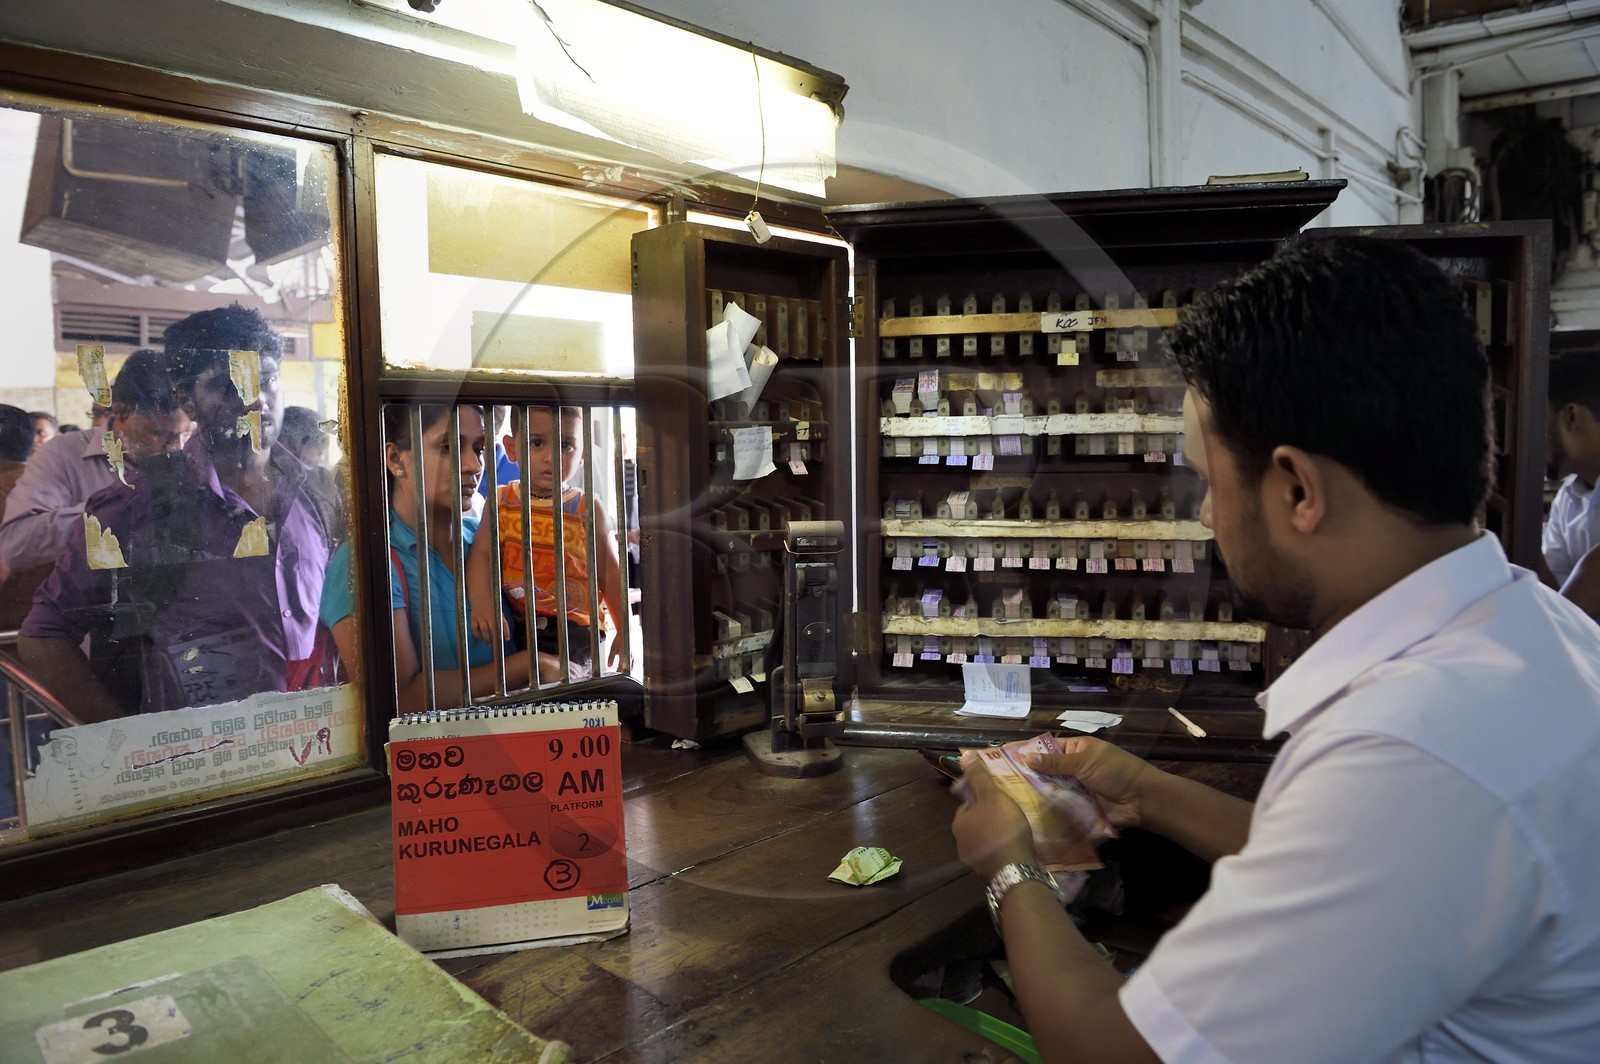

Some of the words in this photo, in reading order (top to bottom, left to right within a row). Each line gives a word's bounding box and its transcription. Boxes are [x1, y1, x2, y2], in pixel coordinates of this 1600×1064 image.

[395, 746, 465, 771] මහව
[548, 734, 611, 761] 9.00
[558, 768, 604, 796] AM
[550, 799, 604, 813] PLATFORM
[398, 816, 459, 837] MAHO
[399, 831, 541, 860] KURUNEGALA
[576, 833, 591, 852] 2
[83, 1009, 148, 1055] 3
